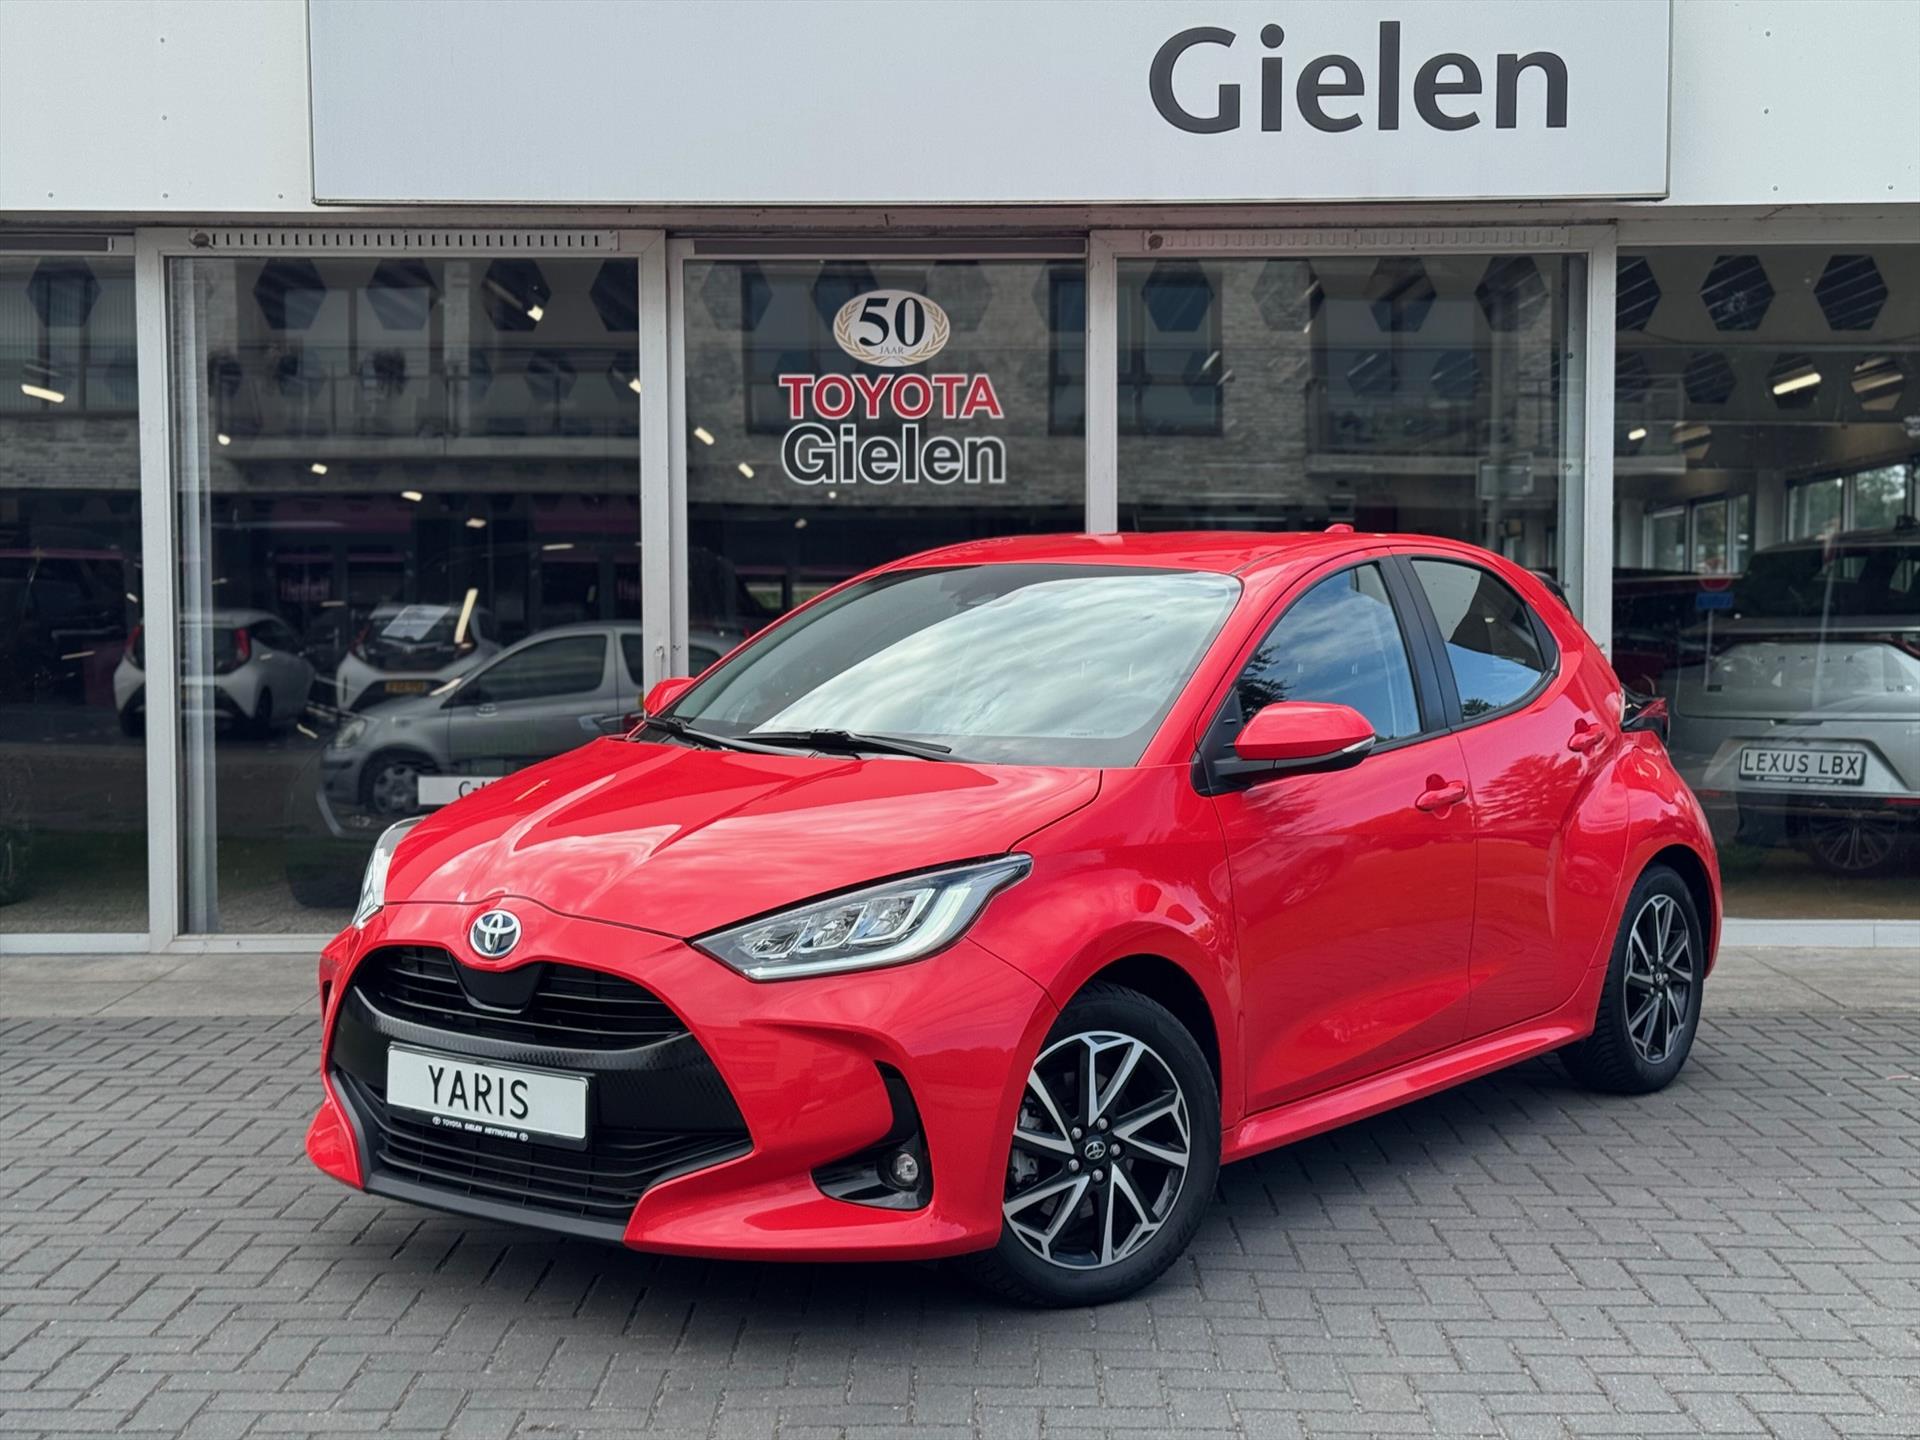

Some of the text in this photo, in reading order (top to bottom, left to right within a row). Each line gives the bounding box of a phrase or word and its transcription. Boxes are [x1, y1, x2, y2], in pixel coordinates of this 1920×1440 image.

[1149, 21, 1568, 134] Gielen
[858, 297, 925, 346] 50
[880, 346, 904, 355] JAAR
[779, 374, 1004, 420] TOYOTA
[781, 422, 1007, 485] Gielen
[1744, 752, 1859, 776] LEXUS LBX
[428, 1065, 529, 1120] YARIS
[442, 1118, 462, 1129] TOYOTA
